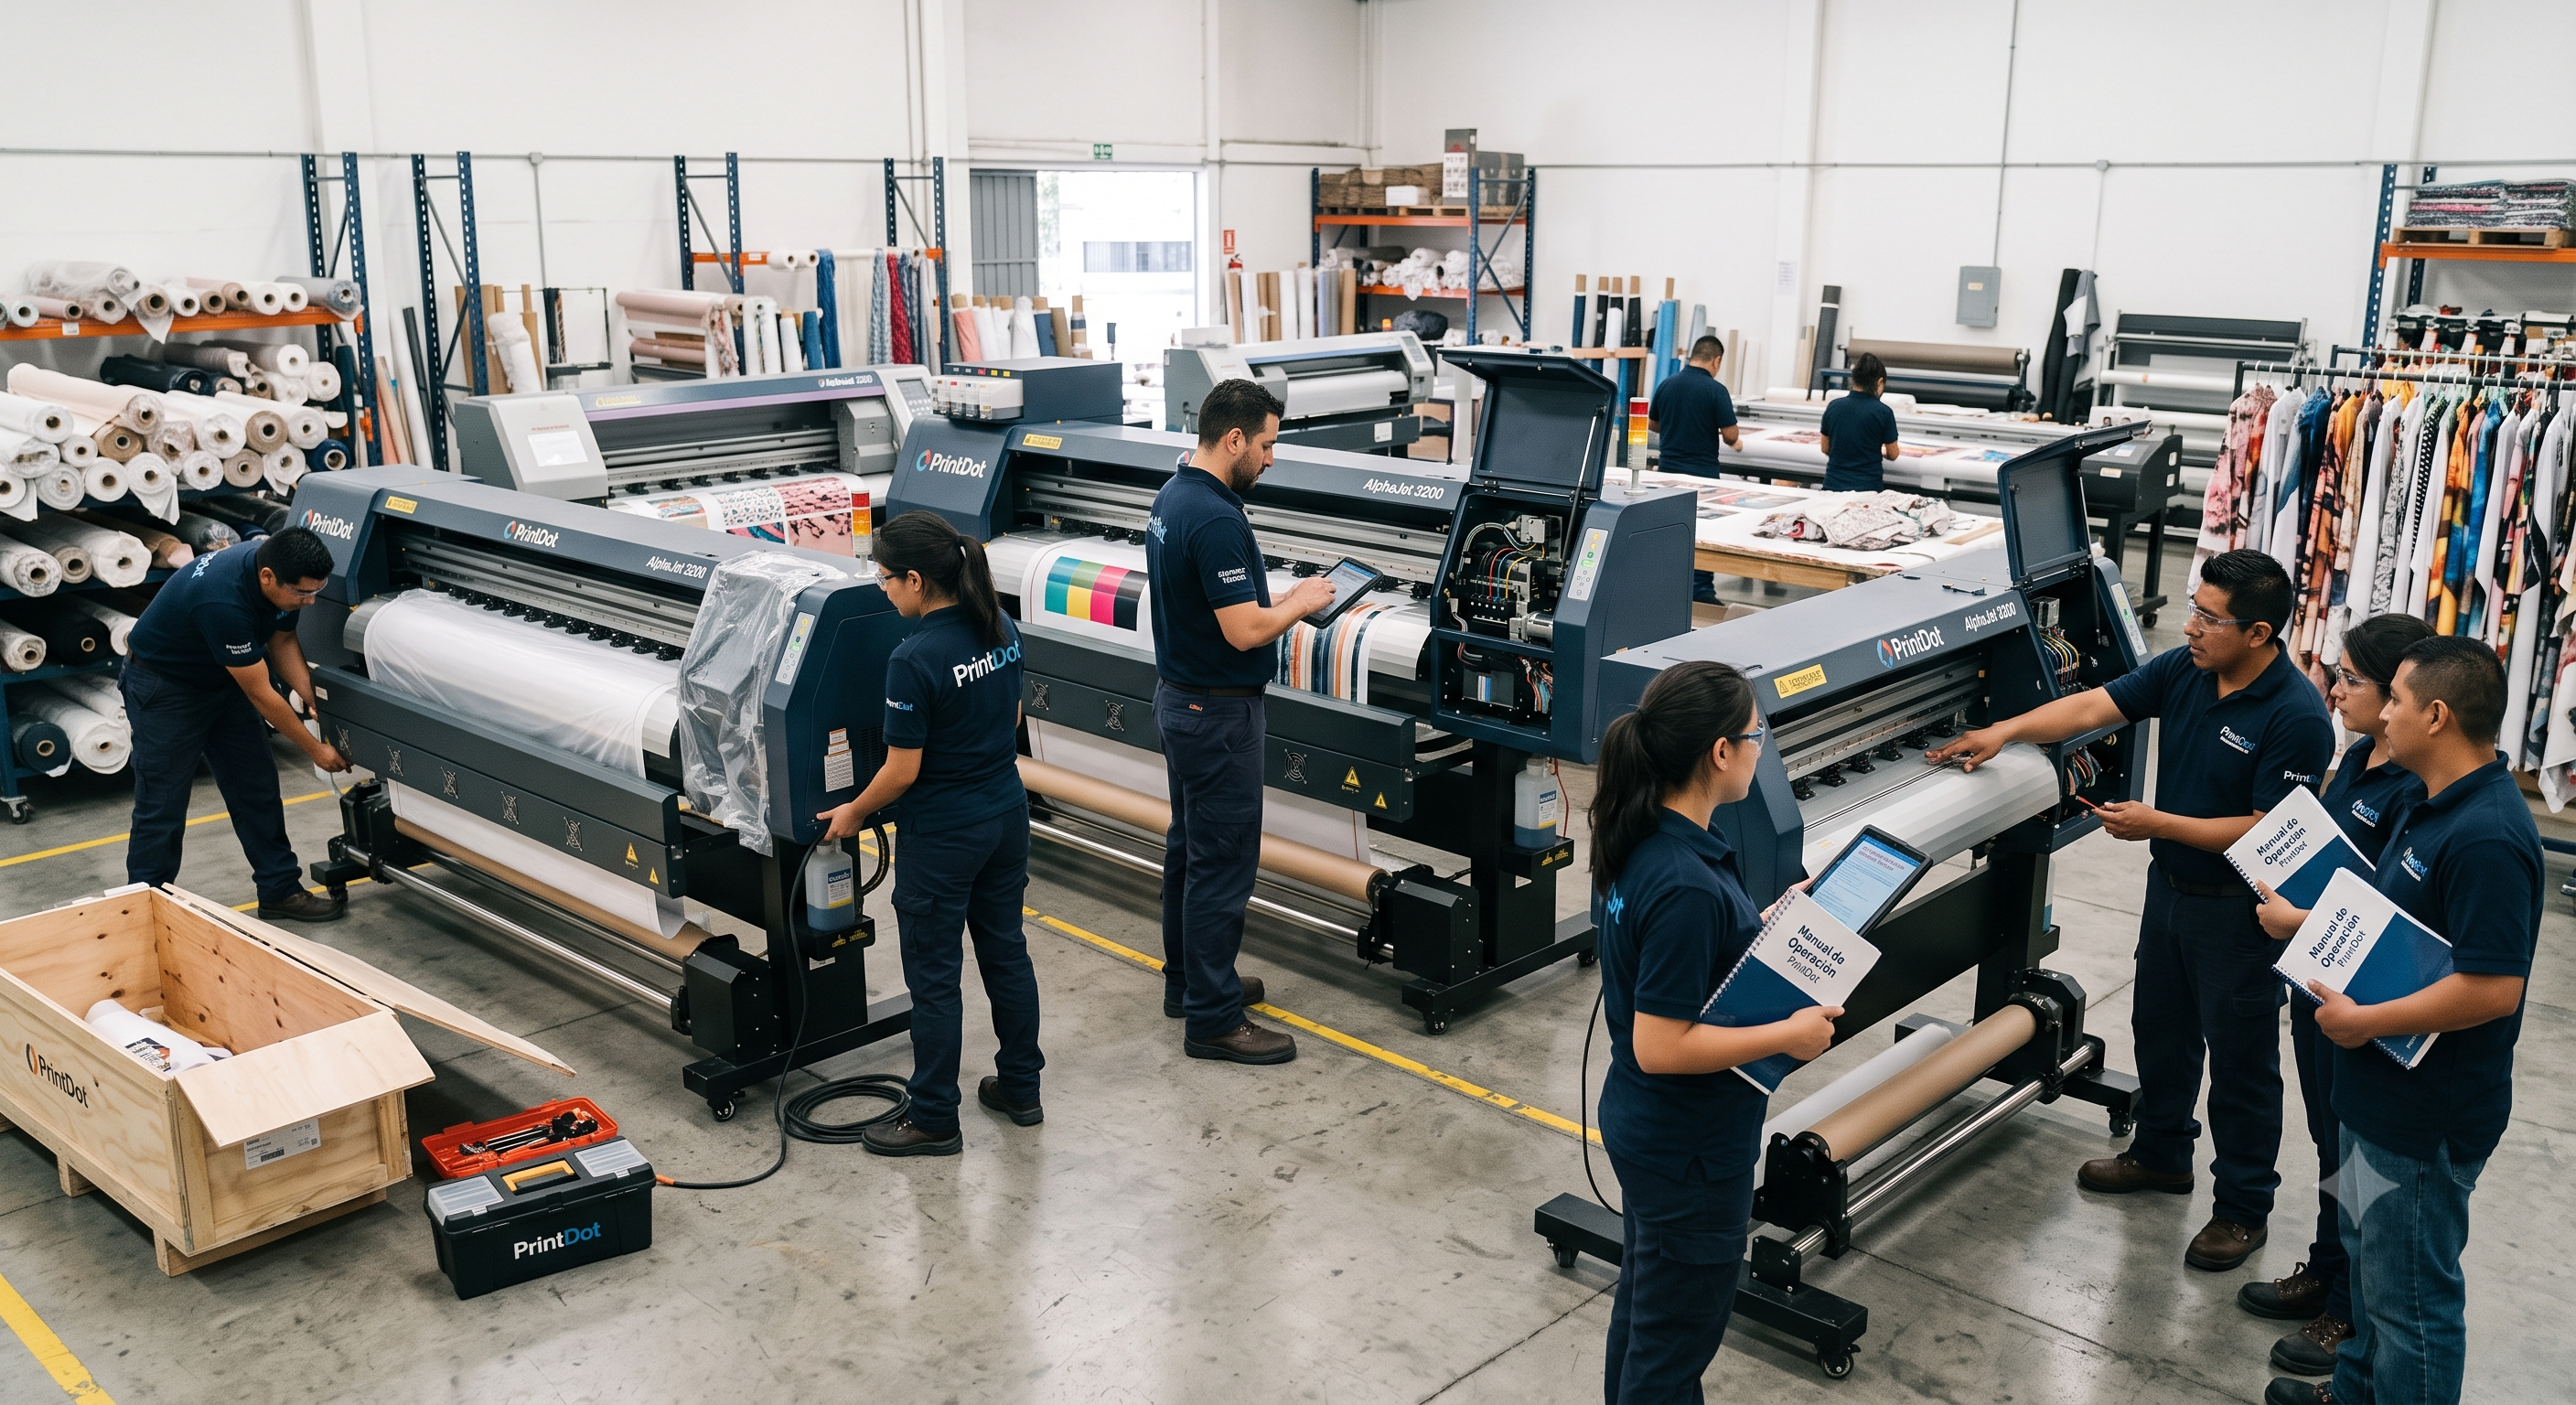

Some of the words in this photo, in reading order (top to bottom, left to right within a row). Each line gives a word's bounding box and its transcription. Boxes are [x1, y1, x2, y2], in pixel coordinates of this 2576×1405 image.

[928, 453, 987, 478] PrintDot
[1413, 485, 1444, 500] 3200
[309, 512, 354, 540] PrintDot
[513, 523, 559, 548] PrintDot
[1890, 626, 1945, 660] PrintDot
[952, 639, 1022, 688] PrintDot
[2256, 826, 2289, 857] Manual
[1798, 925, 1834, 956] Manual
[2308, 919, 2339, 960] Manual
[38, 1054, 89, 1109] PrintDot
[513, 1221, 602, 1260] PrintDot
